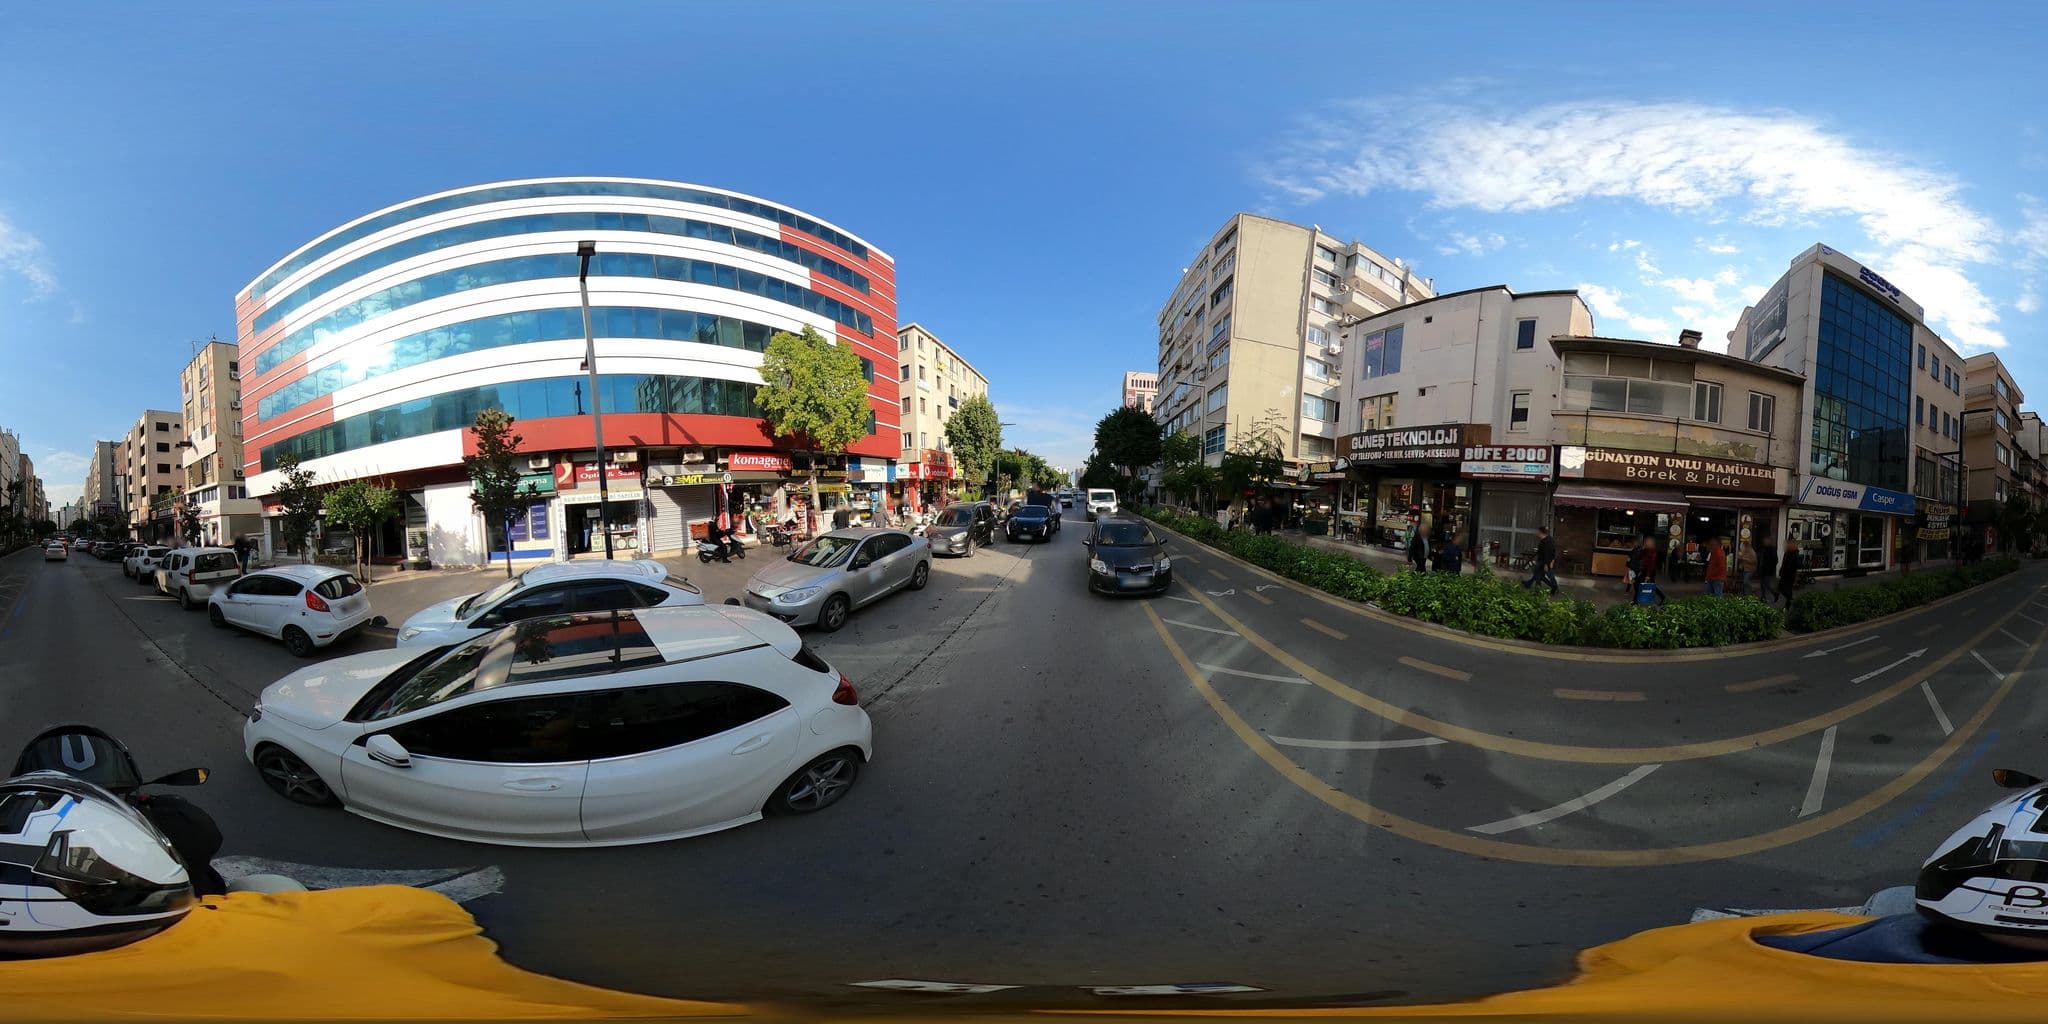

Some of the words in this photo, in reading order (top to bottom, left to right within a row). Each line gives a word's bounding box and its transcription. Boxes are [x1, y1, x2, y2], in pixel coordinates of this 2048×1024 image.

[1464, 445, 1503, 461] BÜFE
[1506, 447, 1547, 462] 2000
[1585, 449, 1660, 466] GÜNAYDIN
[1665, 458, 1702, 470] UNLU
[580, 471, 603, 480] Opti
[1626, 466, 1678, 481] Börek
[1685, 471, 1699, 483] &
[1706, 473, 1741, 487] Pide
[1842, 489, 1858, 500] GSM
[1872, 492, 1896, 506] Casper
